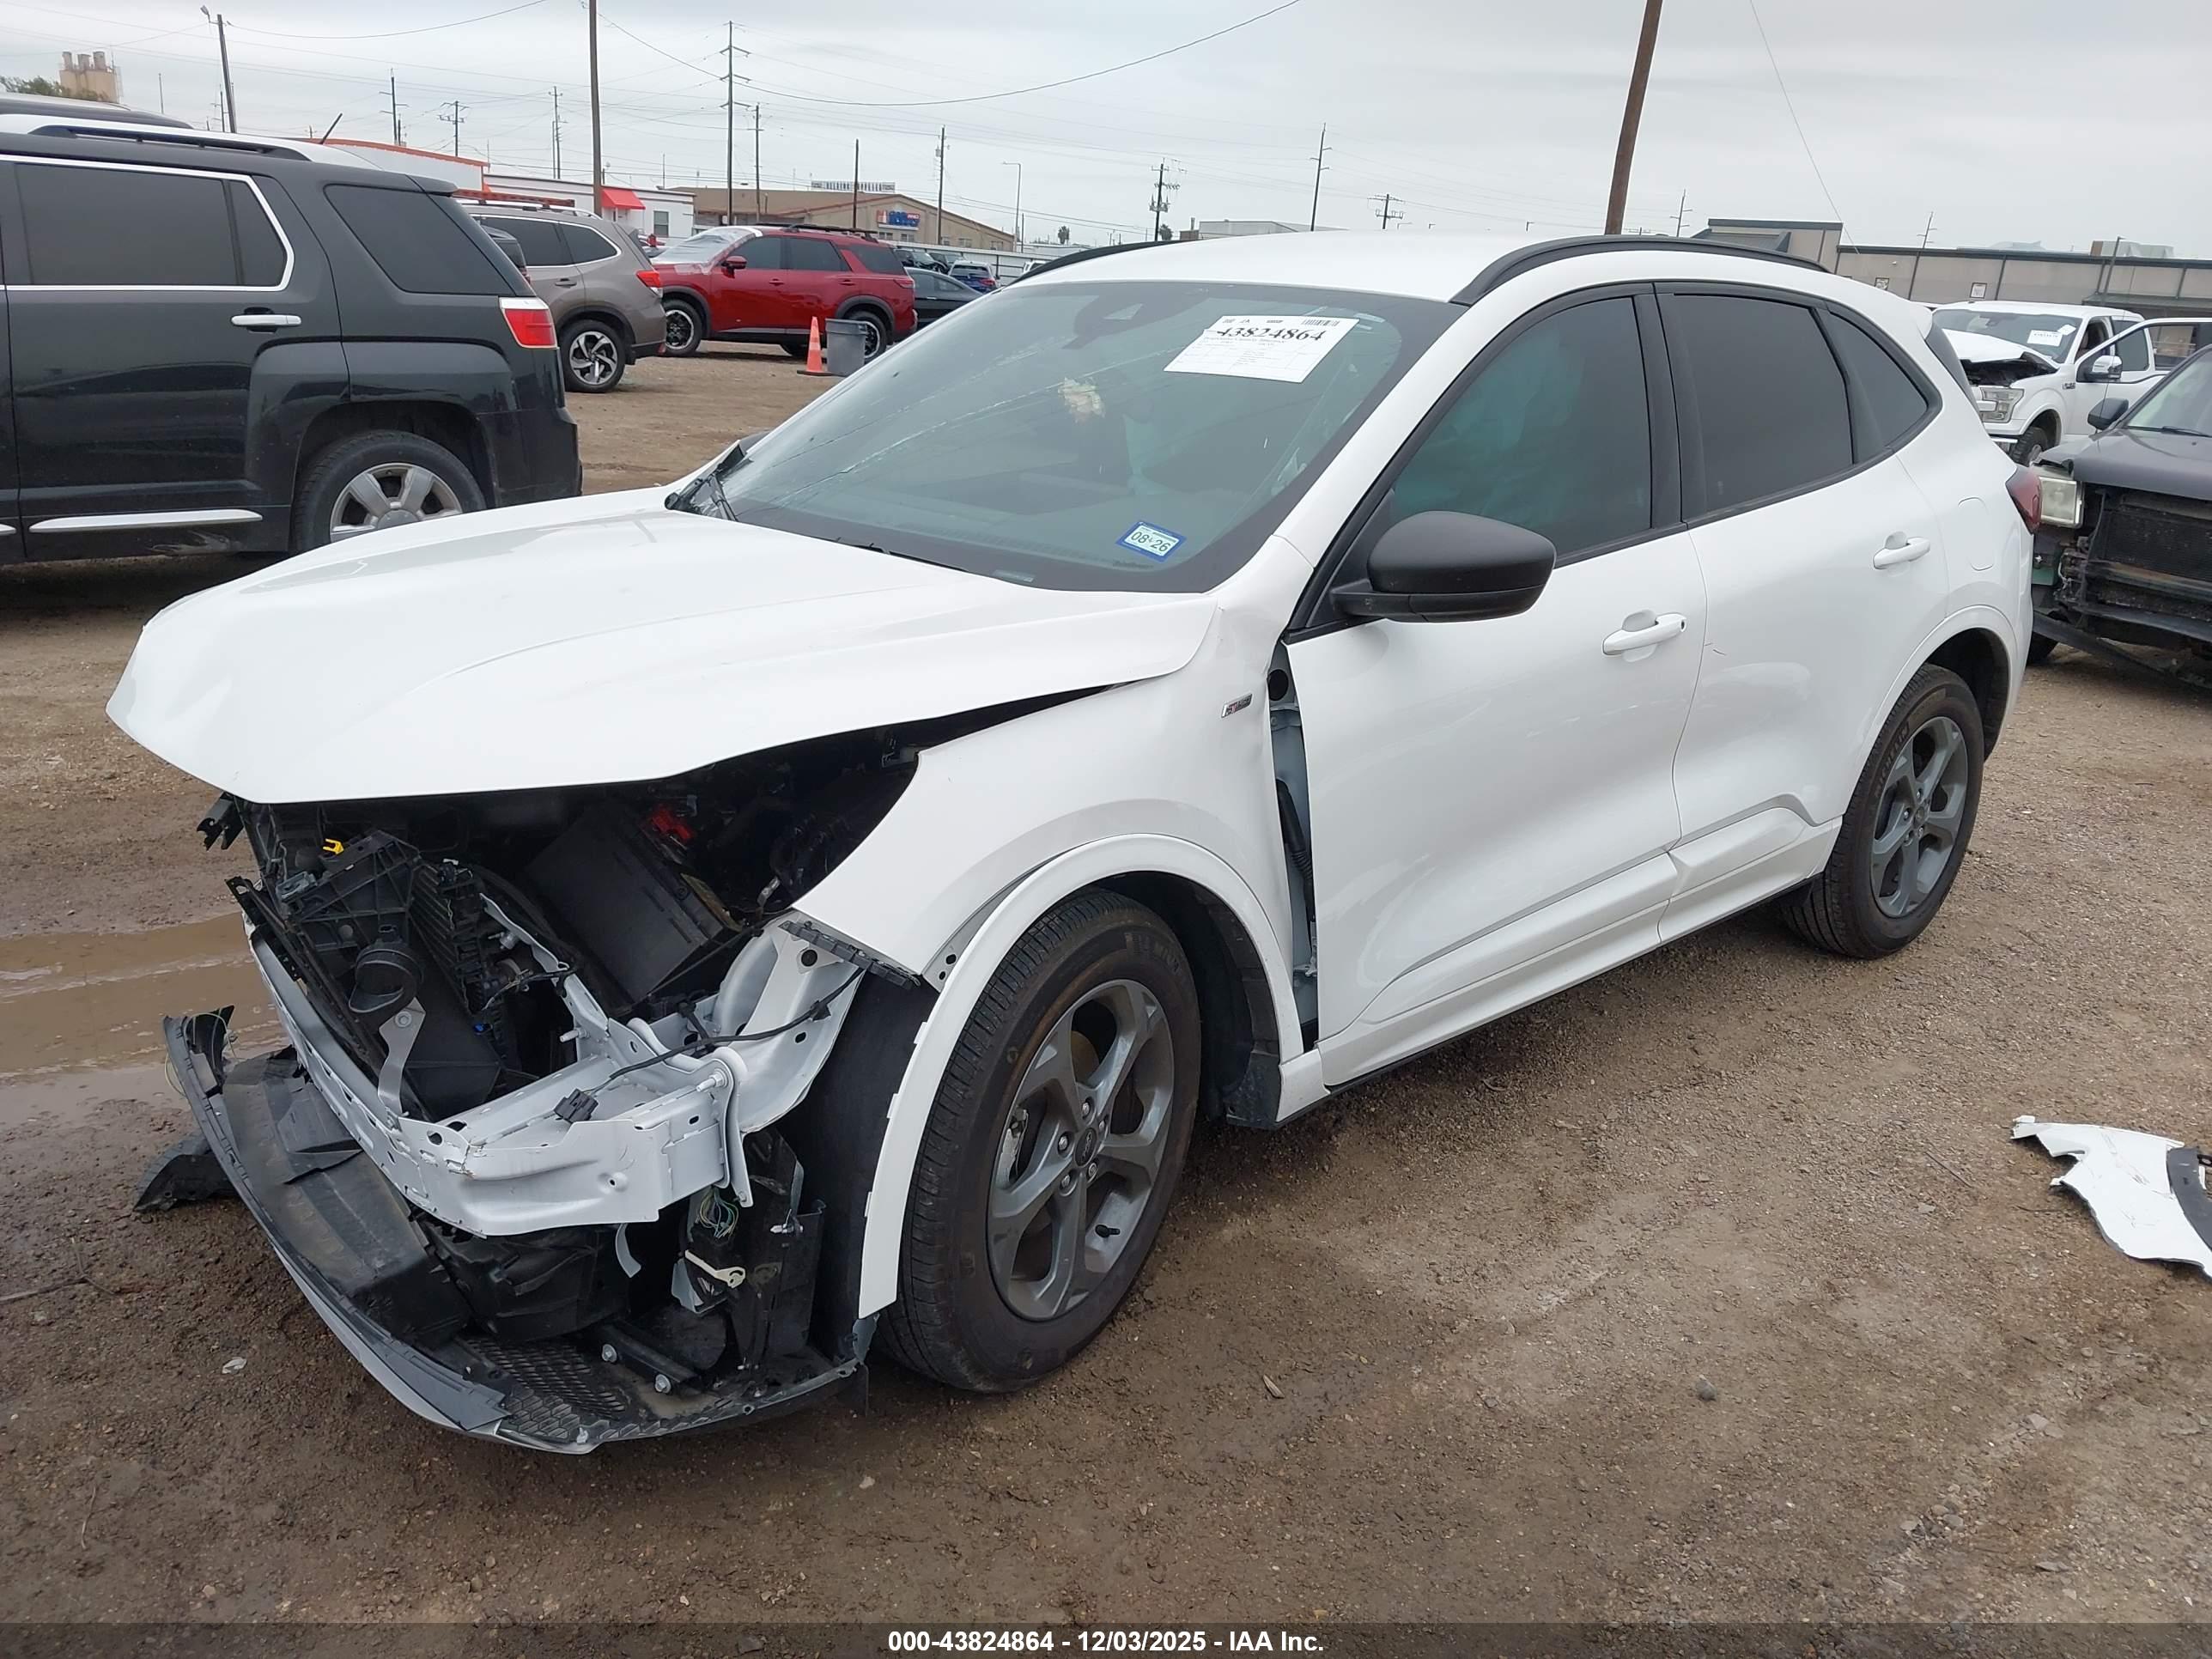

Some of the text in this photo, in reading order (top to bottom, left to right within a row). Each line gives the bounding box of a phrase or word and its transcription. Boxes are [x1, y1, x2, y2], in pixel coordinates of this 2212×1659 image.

[1217, 327, 1327, 341] 43824864
[1131, 531, 1150, 544] 08
[1151, 539, 1171, 552] 26
